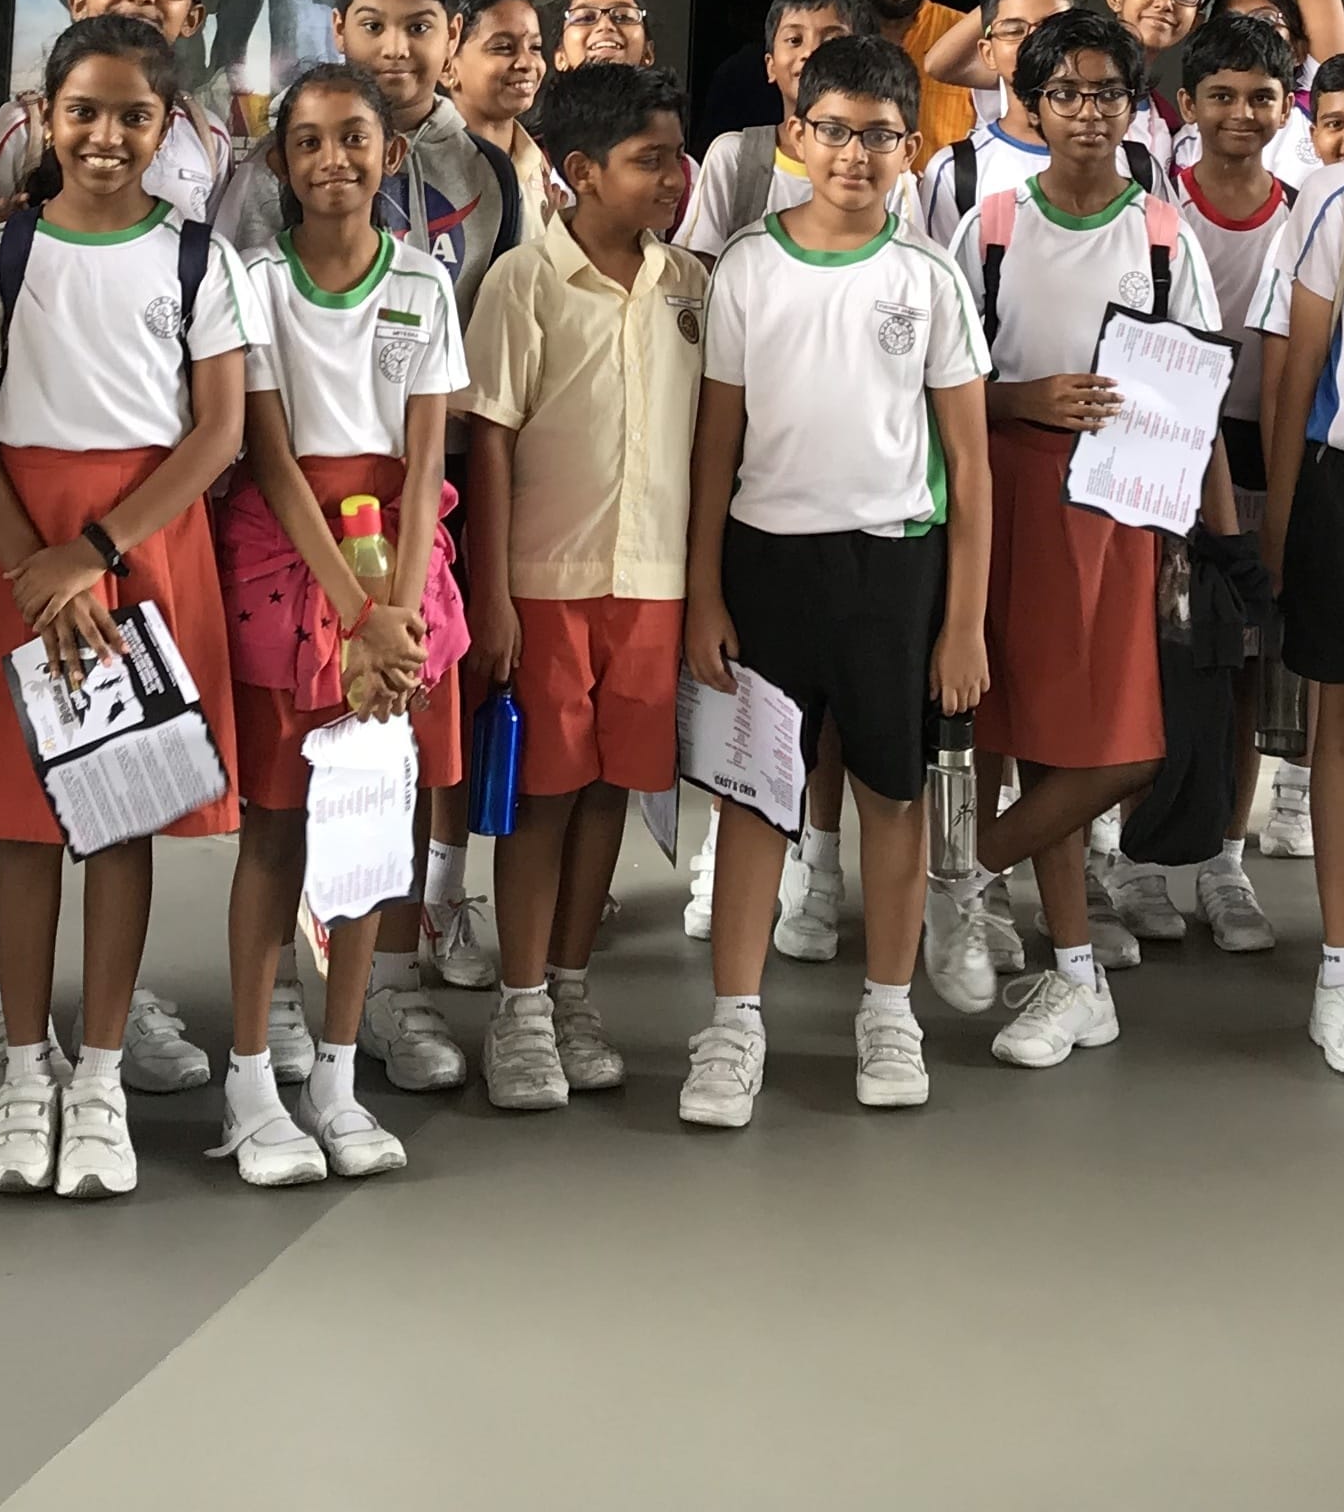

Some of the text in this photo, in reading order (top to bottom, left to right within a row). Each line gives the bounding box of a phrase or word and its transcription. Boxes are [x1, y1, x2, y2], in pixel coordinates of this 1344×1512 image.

[714, 774, 757, 799] CAST & CREW
